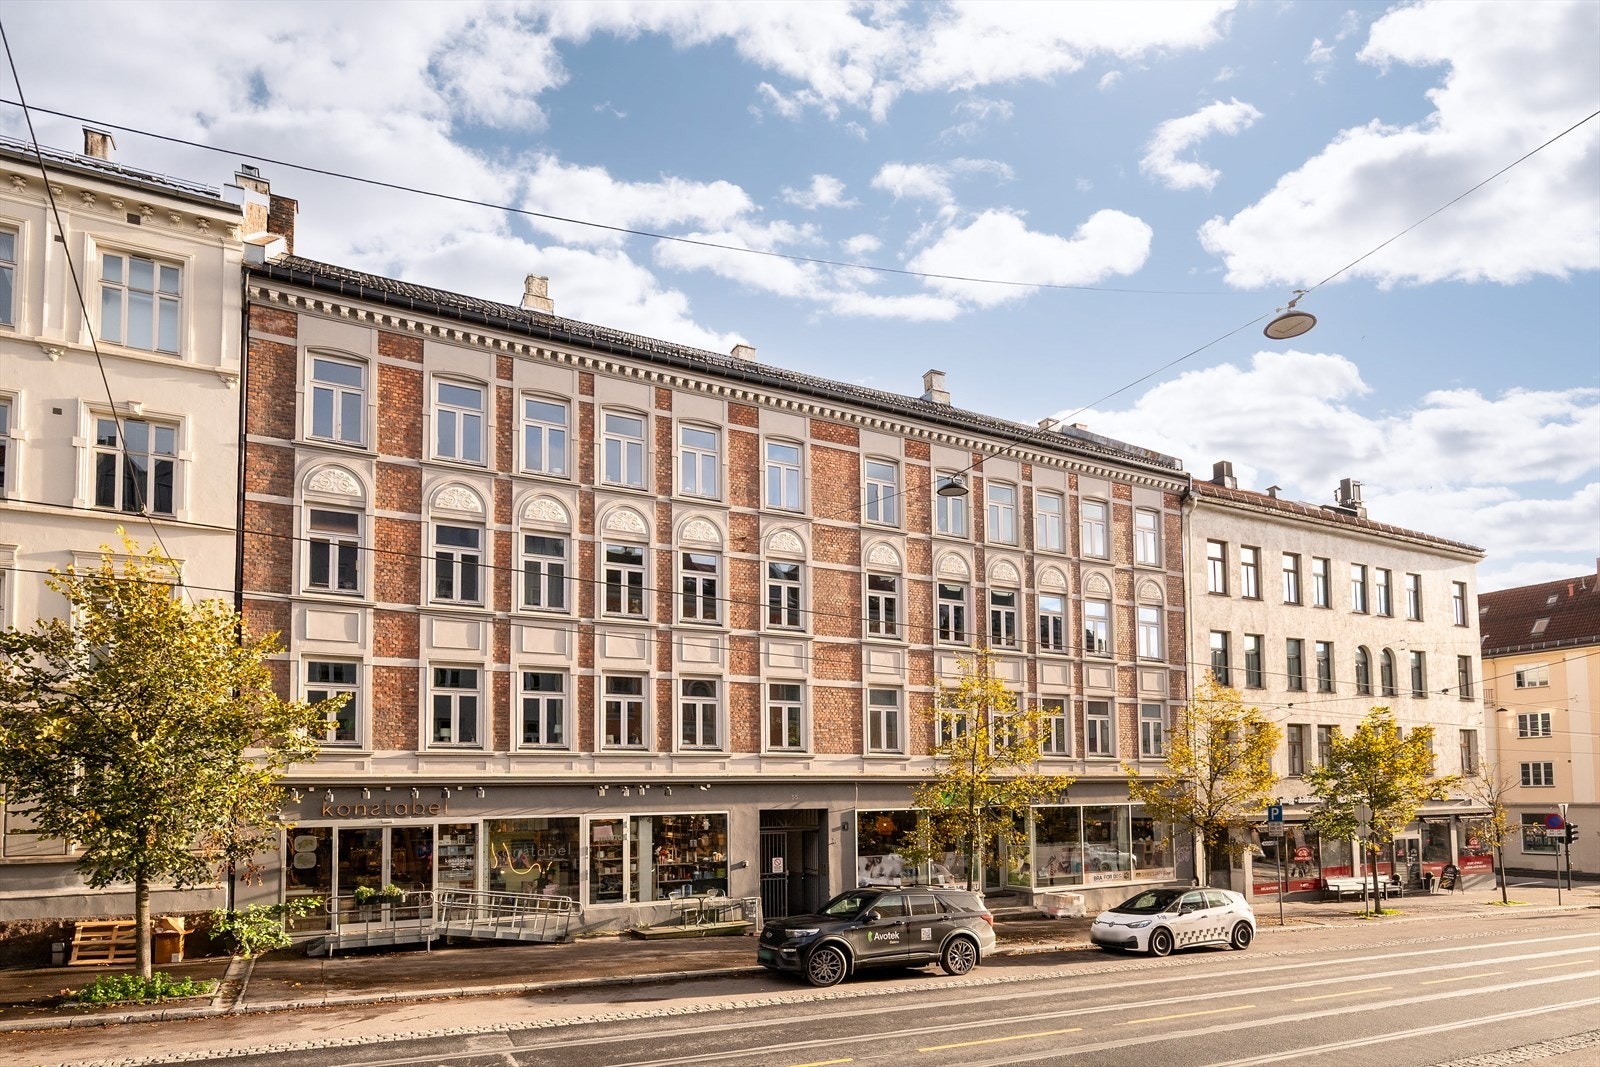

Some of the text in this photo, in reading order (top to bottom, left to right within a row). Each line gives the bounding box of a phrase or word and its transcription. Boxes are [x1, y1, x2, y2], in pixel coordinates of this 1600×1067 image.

[322, 799, 448, 817] konstabel
[1271, 807, 1280, 820] P
[874, 931, 900, 941] Avotek
